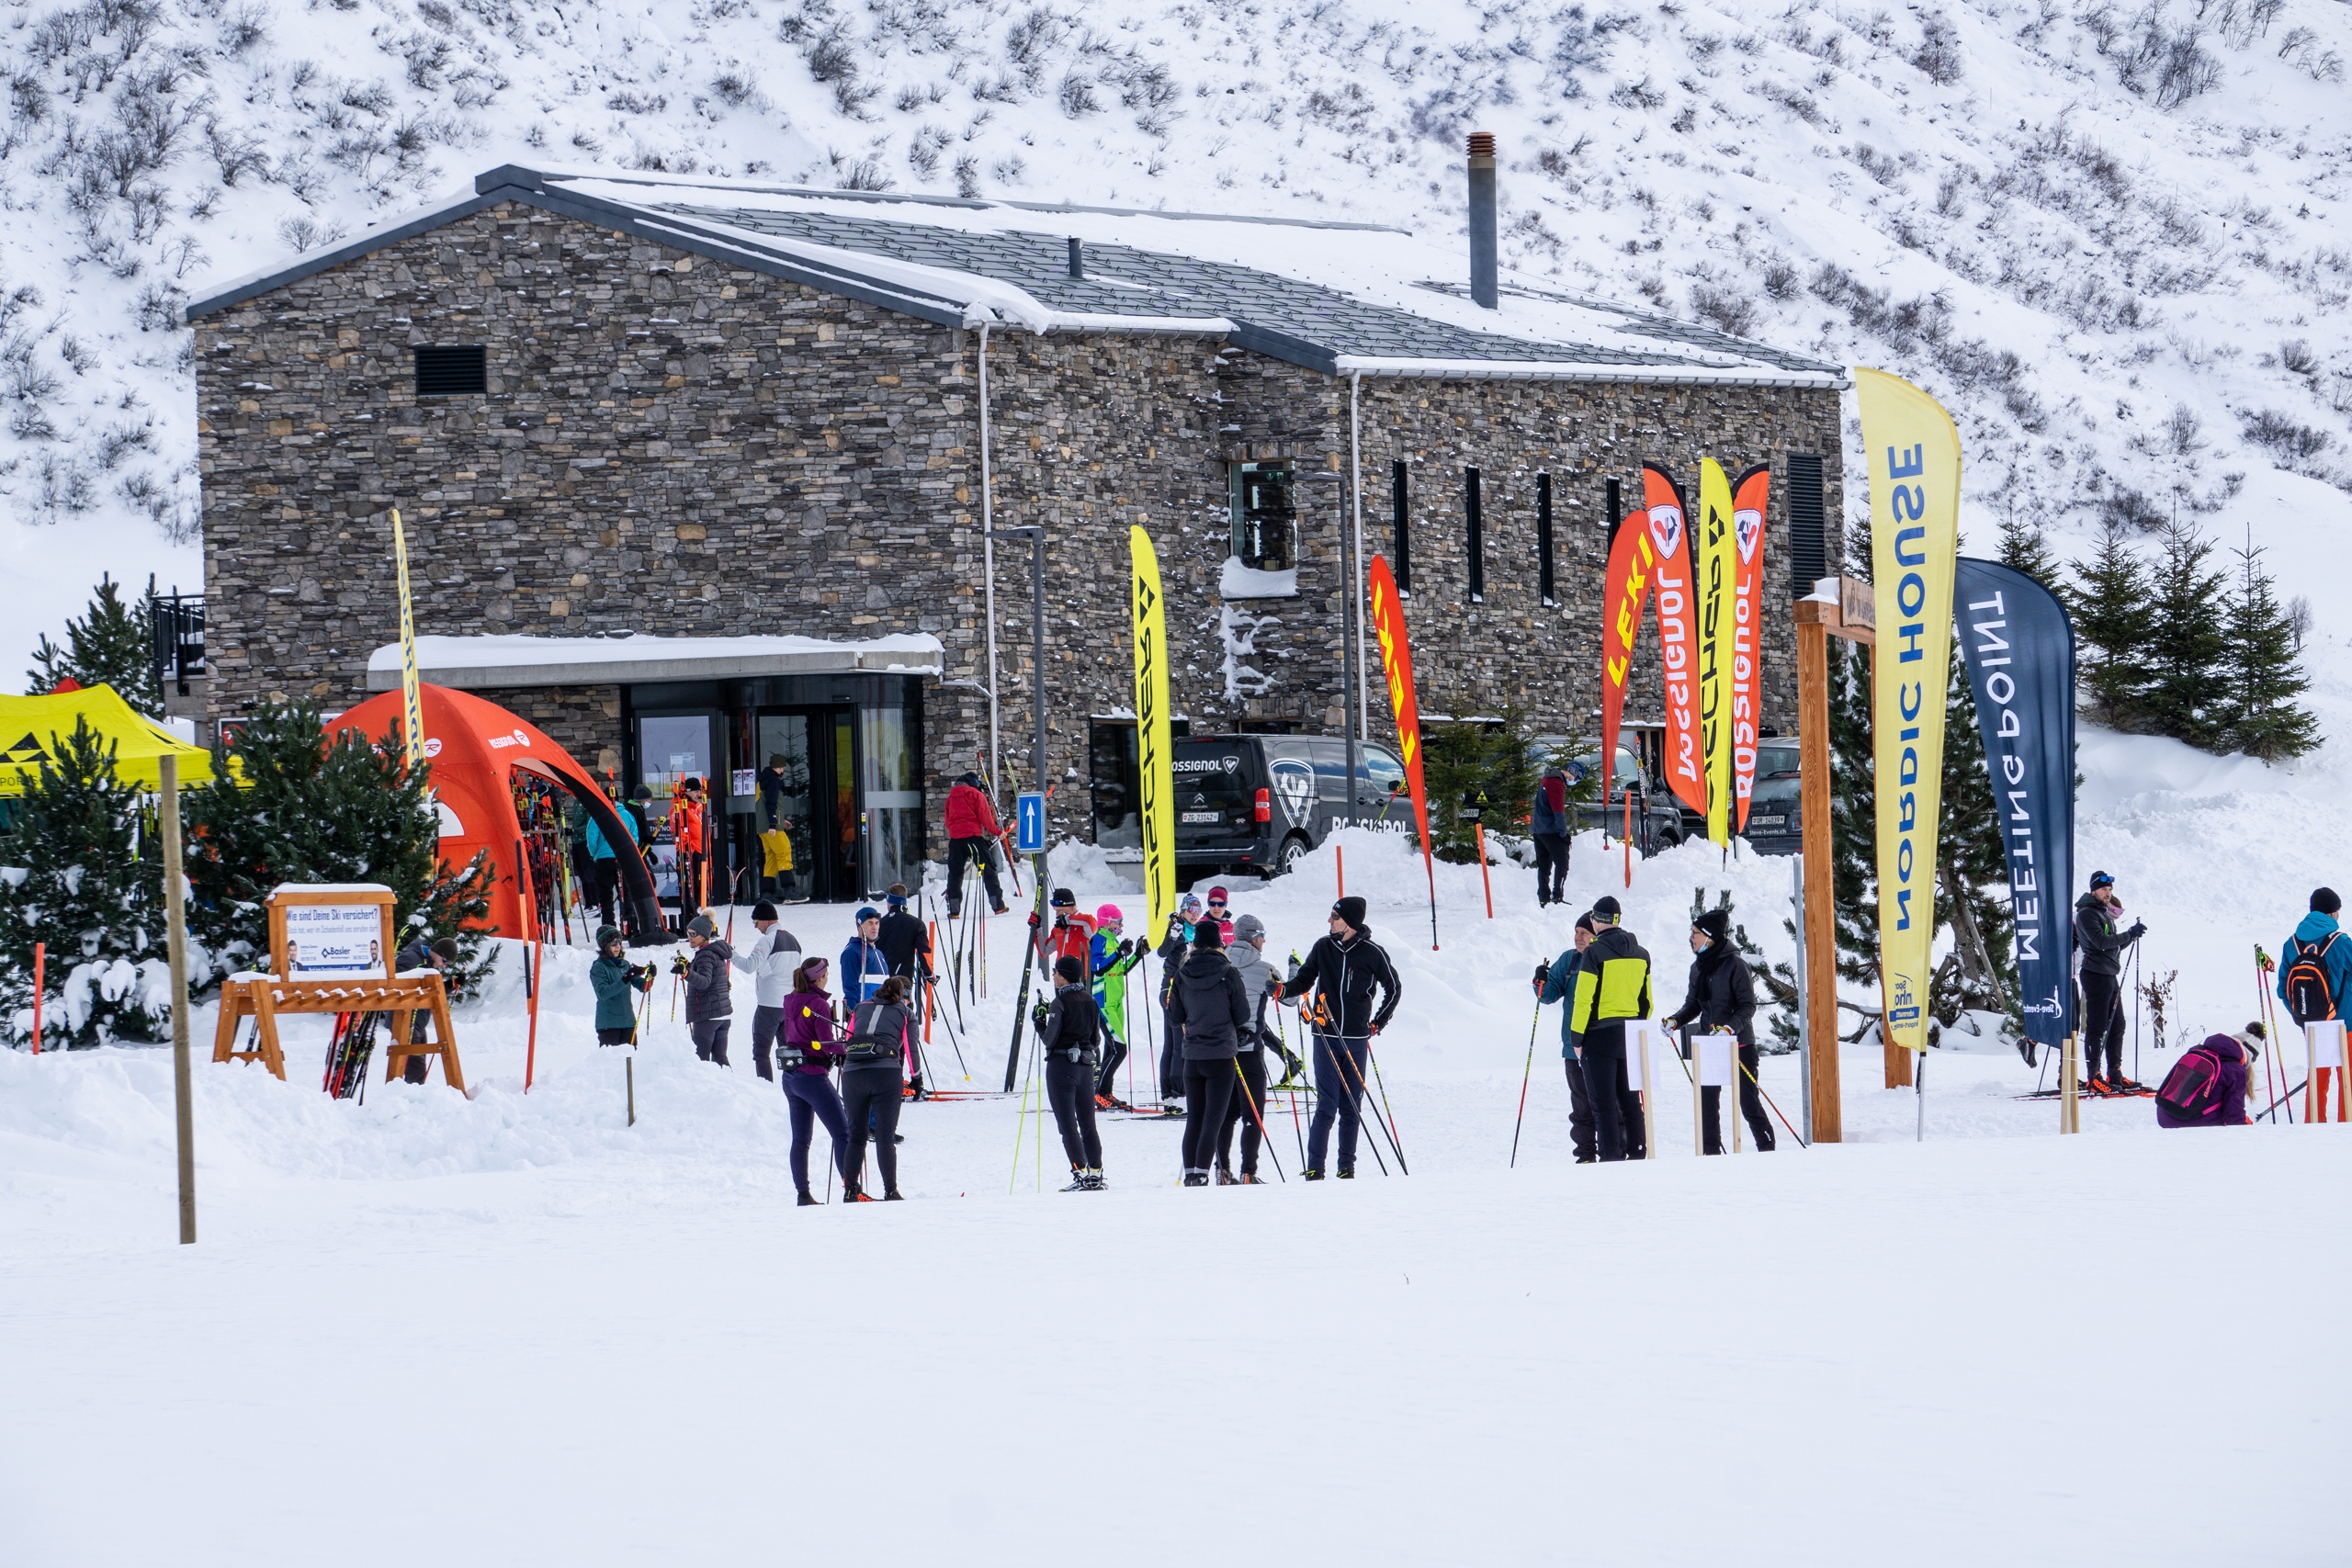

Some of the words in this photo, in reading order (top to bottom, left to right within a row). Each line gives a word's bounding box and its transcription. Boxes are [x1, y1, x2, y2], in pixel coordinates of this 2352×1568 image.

[1607, 531, 1654, 688] LEKI
[1735, 573, 1758, 799] ROSSIGNOL
[1171, 760, 1222, 772] OSSIGNOL
[1638, 768, 1646, 798] ROSSIGNO
[1332, 816, 1407, 832] ROSIGNOL
[287, 909, 298, 920] Wie
[300, 909, 311, 920] sind
[313, 909, 330, 920] Deine
[332, 908, 341, 920] Ski
[342, 908, 378, 920] versichert?
[330, 946, 351, 955] Basler
